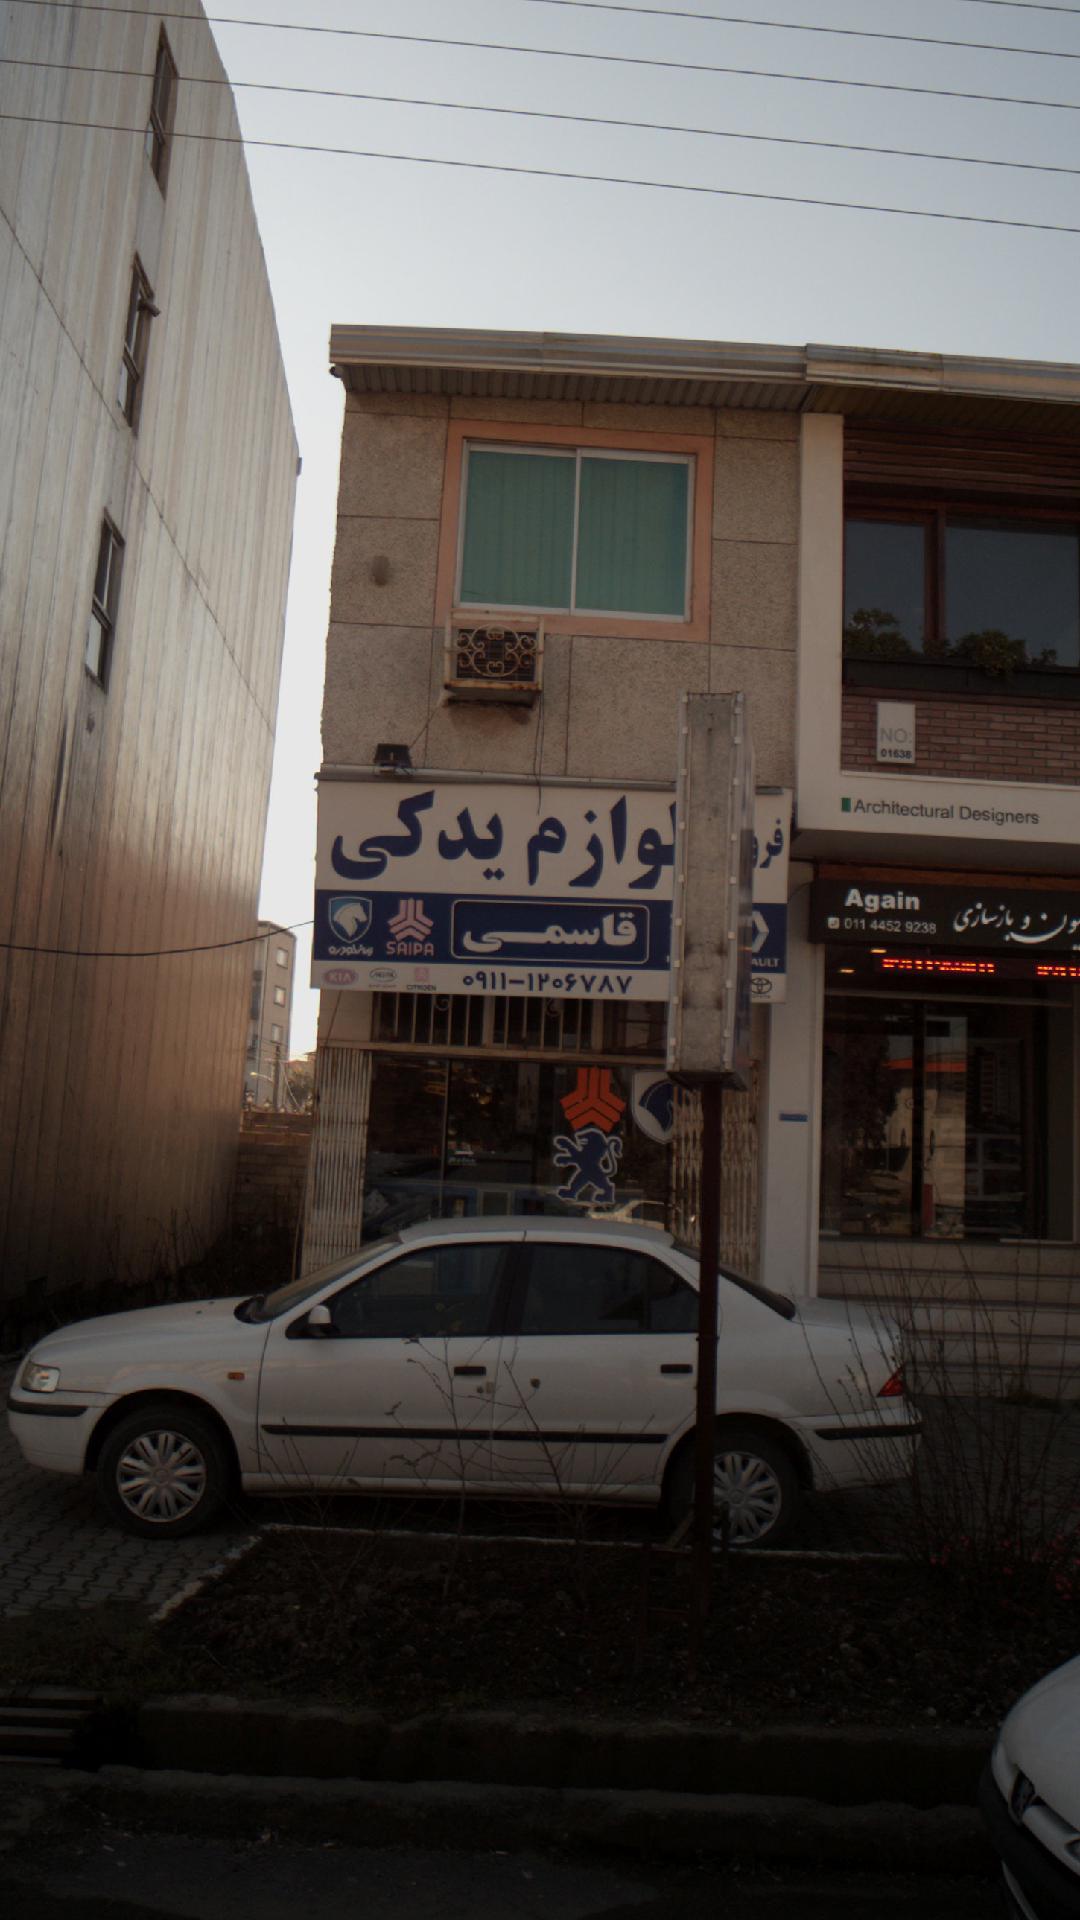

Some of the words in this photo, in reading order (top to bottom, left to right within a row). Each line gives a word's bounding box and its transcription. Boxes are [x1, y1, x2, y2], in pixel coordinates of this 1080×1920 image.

[854, 799, 954, 820] Architectural
[960, 805, 1040, 826] Designers
[331, 790, 503, 882] یدکی
[844, 888, 921, 913] Again
[462, 911, 638, 954] قاسمی
[844, 918, 866, 931] 011
[870, 919, 902, 933] 4452
[905, 920, 937, 935] 9238
[385, 941, 435, 957] SAIPA
[327, 972, 353, 983] KIA
